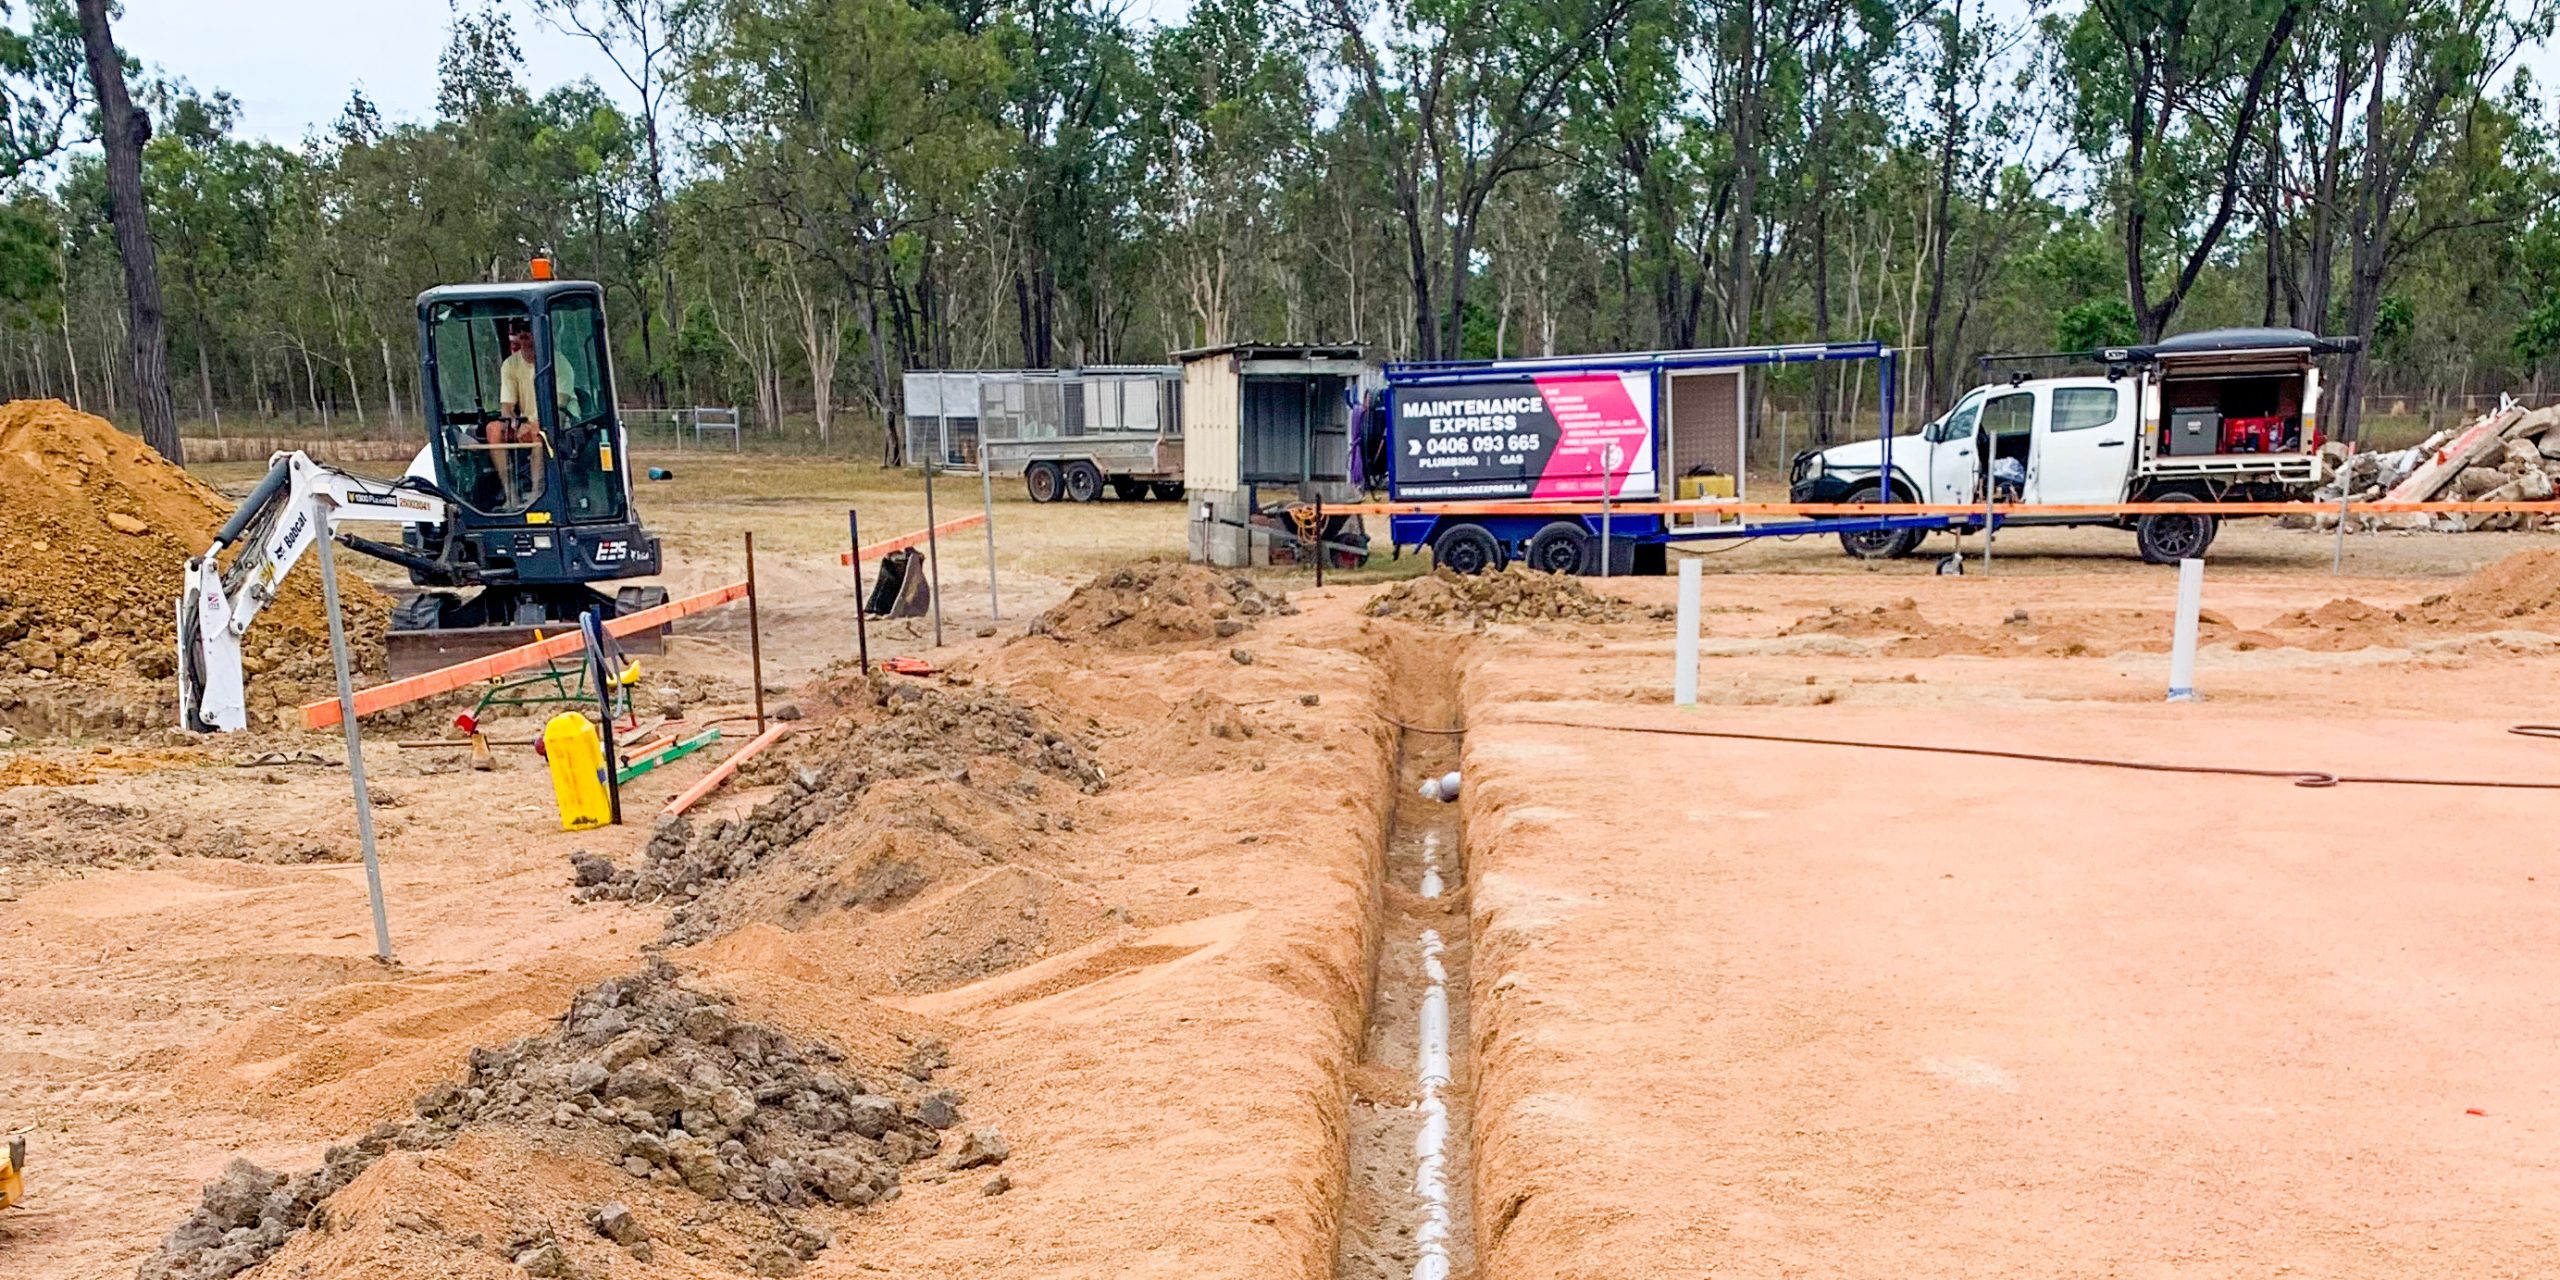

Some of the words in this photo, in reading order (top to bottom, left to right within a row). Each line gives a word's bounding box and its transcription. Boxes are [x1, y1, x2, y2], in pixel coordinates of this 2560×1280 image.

[1403, 397, 1543, 418] MAINTENANCE
[1429, 415, 1518, 434] EXPRESS
[1426, 437, 1469, 455] 0406
[1471, 435, 1504, 452] 093
[1507, 434, 1540, 451] 665
[1419, 456, 1479, 468] PLUMBING
[1499, 454, 1524, 465] GAS
[283, 511, 307, 549] Bobcat
[595, 541, 628, 561] E25
